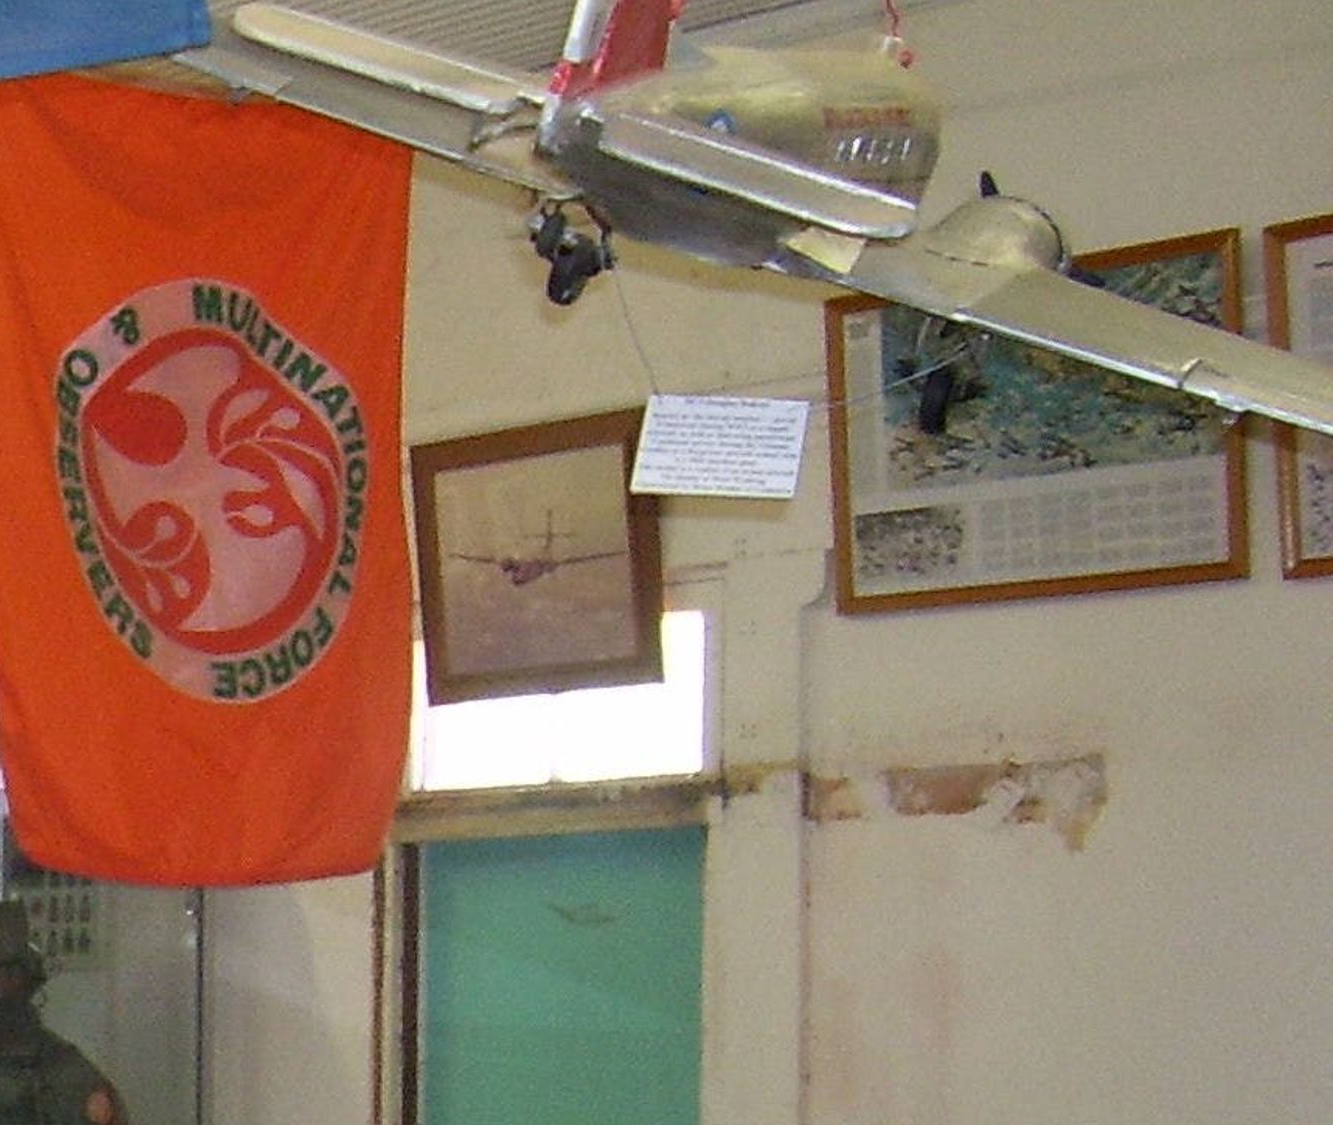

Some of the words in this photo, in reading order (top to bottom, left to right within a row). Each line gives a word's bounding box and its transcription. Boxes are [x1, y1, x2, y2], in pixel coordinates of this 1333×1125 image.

[111, 307, 141, 346] &
[56, 348, 153, 660] OBSERVERS
[193, 285, 367, 596] MULTINATIONAL
[211, 606, 336, 700] FORCE
